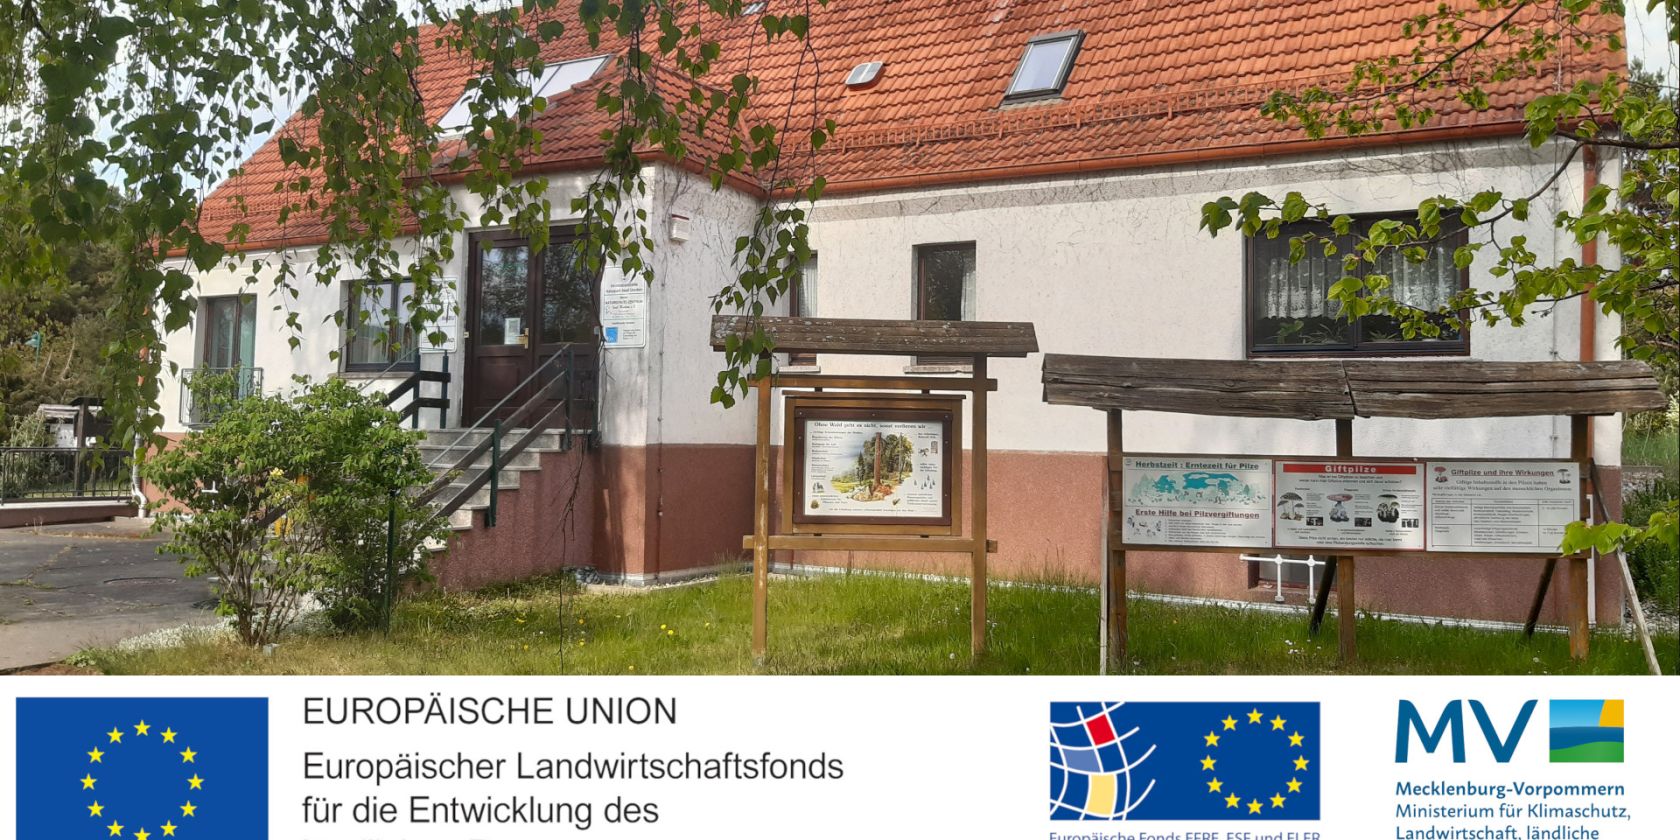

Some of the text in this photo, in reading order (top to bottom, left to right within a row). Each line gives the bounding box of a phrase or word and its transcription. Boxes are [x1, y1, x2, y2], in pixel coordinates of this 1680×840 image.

[1135, 460, 1178, 469] Herbstzeit
[1185, 461, 1224, 470] Erntezeit
[1225, 462, 1237, 470] für
[1324, 464, 1377, 474] Giftpilze
[1451, 468, 1481, 477] Giftpilze
[1515, 469, 1554, 478] Wirkungen
[1135, 508, 1260, 519] Erste Hilfe bei Pilzvergiftungen
